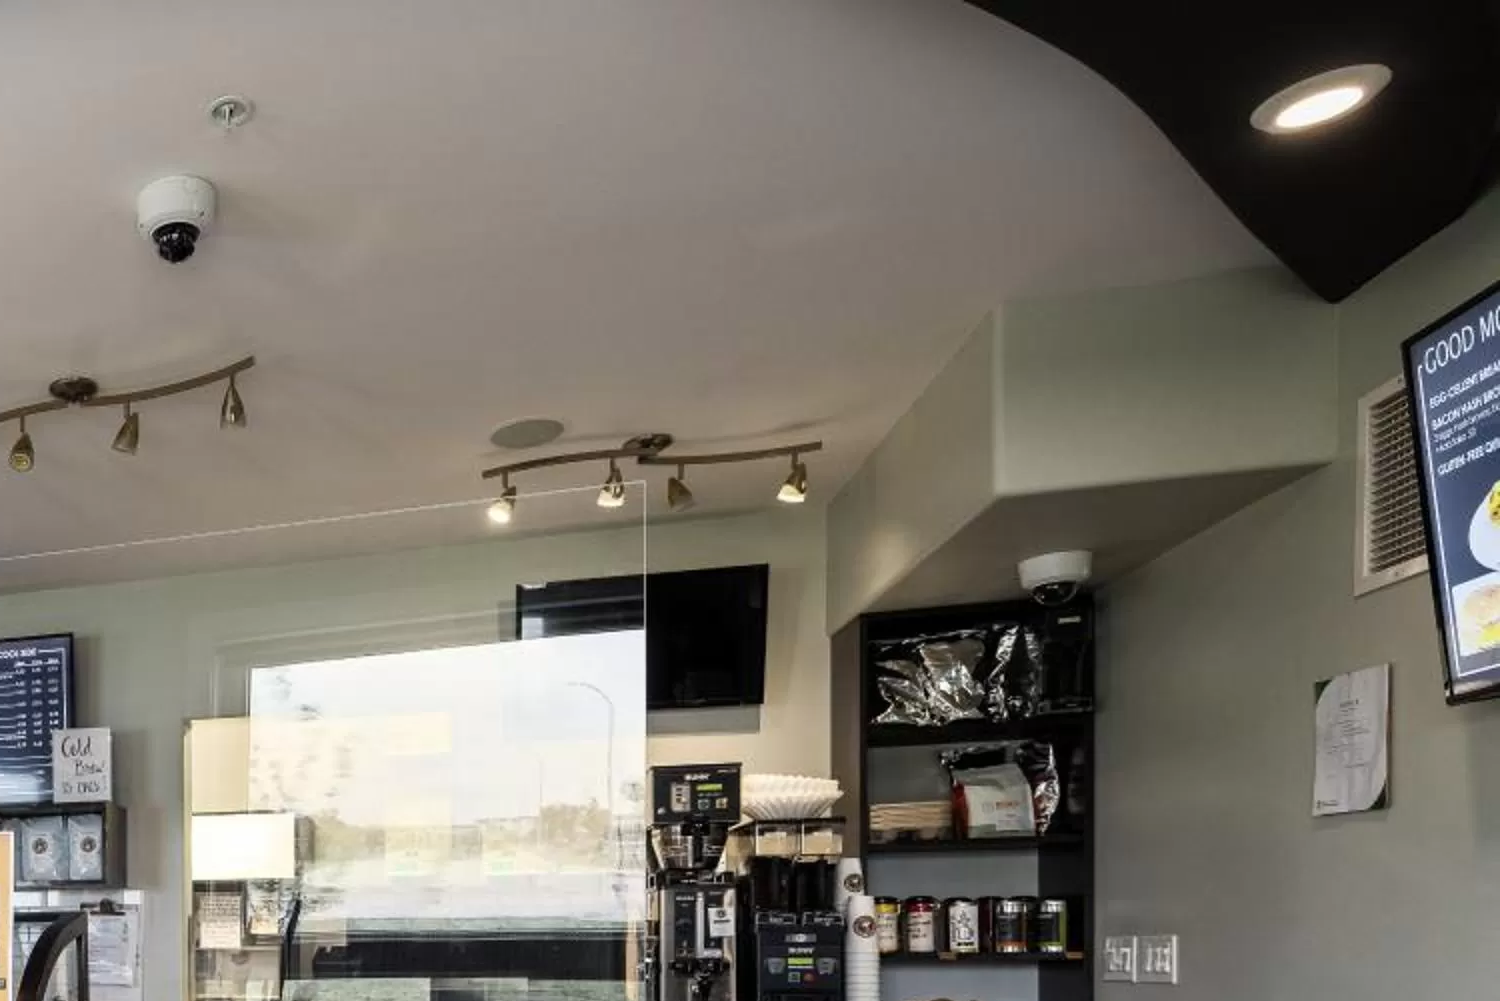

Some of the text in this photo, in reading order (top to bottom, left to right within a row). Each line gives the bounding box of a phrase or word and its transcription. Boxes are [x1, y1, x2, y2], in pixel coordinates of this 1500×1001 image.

[1424, 324, 1475, 374] GOOD
[1432, 408, 1461, 431] BACON
[61, 735, 91, 757] Cold
